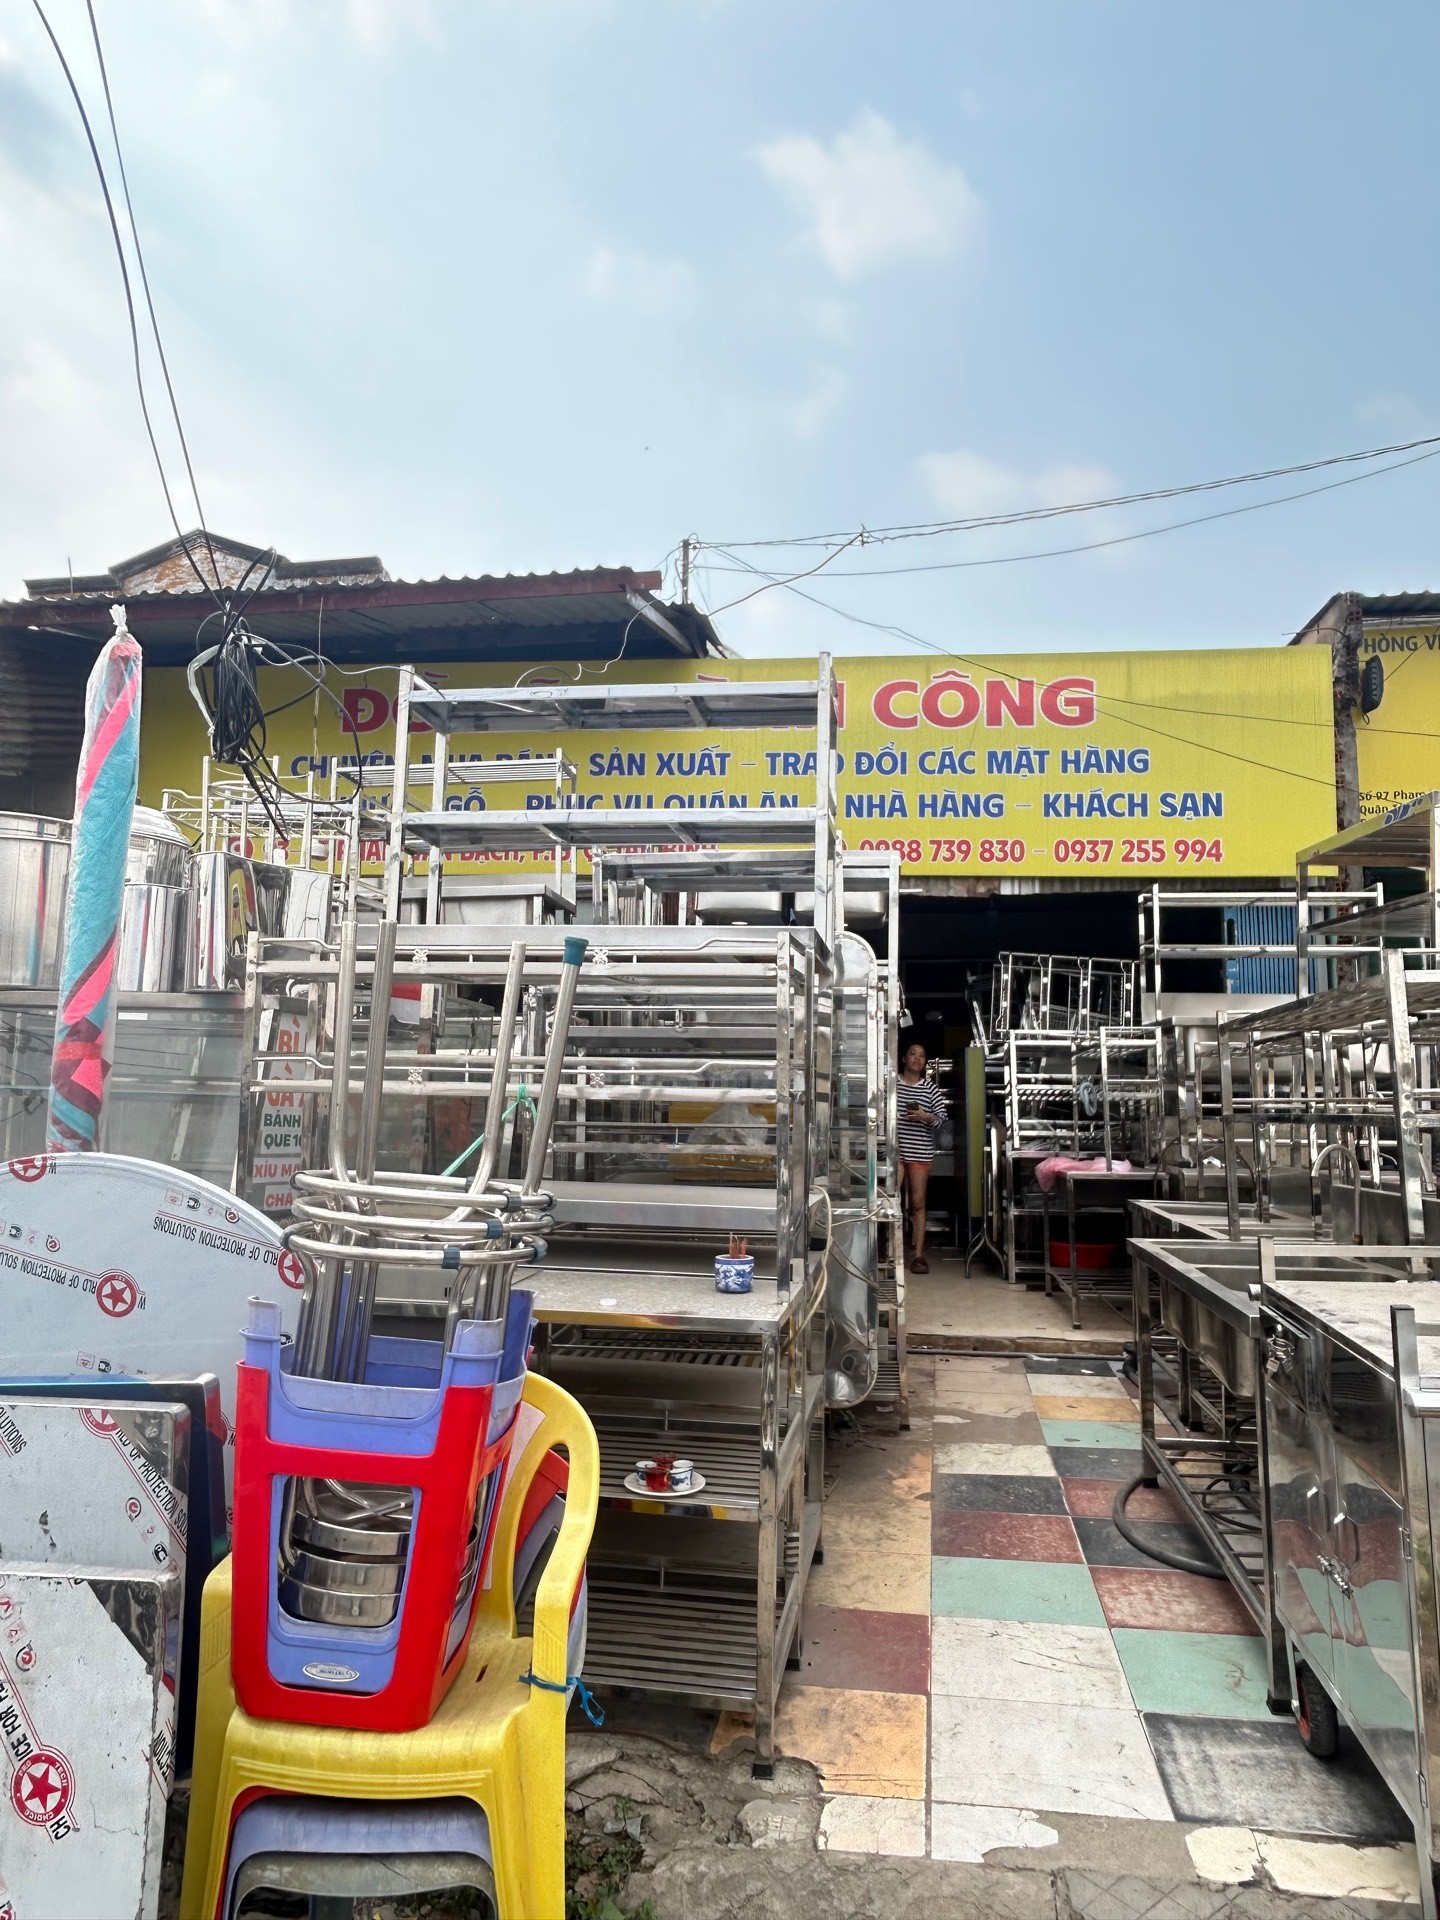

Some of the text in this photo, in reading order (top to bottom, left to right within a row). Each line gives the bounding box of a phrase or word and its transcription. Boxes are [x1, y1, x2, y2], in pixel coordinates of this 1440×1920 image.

[1361, 633, 1418, 653] HÒNG
[873, 670, 1095, 728] CÔNG
[589, 747, 645, 776] SẢN
[655, 745, 731, 776] XUẤT
[853, 742, 907, 776] ĐỔI
[918, 746, 975, 775] CÁC
[987, 746, 1050, 777] MẶT
[1061, 744, 1149, 774] HÀNG
[845, 790, 908, 818] NHÀ
[918, 789, 1004, 818] HÀNG
[1043, 788, 1148, 818] KHÁCH
[1160, 792, 1223, 820] SẠN
[929, 840, 971, 862] 739
[979, 839, 1025, 862] 830
[1053, 839, 1114, 863] 0937
[1120, 839, 1166, 863] 255
[1173, 839, 1223, 863] 994
[264, 1133, 291, 1149] QUE
[153, 1216, 197, 1241] SOLUTIONS
[199, 1230, 247, 1257] PROTECTION
[249, 1246, 261, 1261] OF
[21, 1257, 67, 1285] PROTECTION
[68, 1275, 80, 1289] OF
[140, 1461, 177, 1520] PROTECTION
